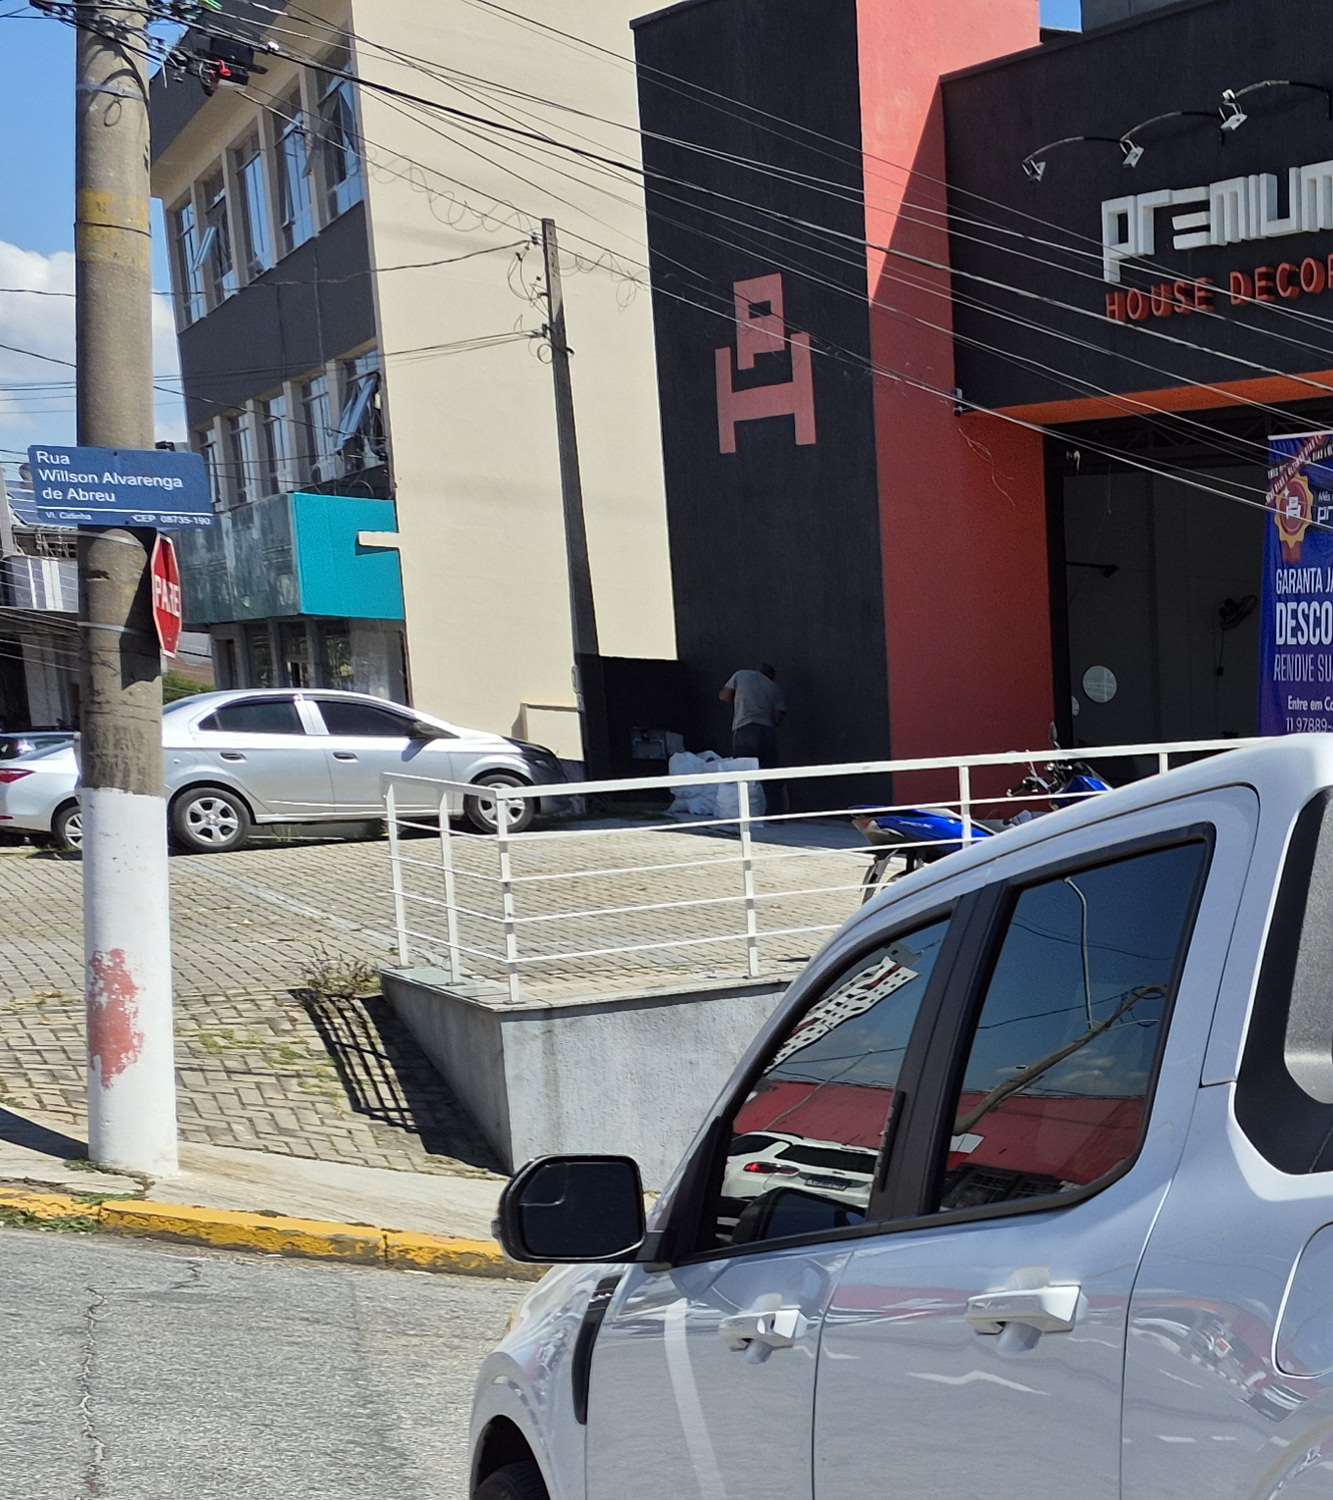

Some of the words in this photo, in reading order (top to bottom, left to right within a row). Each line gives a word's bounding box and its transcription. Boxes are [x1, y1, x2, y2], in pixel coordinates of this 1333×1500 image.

[1105, 277, 1216, 324] HOUSE
[36, 450, 71, 465] Rua
[38, 468, 99, 485] Willson
[102, 471, 184, 491] Alvarenga
[42, 486, 63, 500] de
[66, 488, 116, 503] Abreu
[133, 515, 157, 523] CEP
[160, 515, 211, 526] 08735-190
[1275, 567, 1323, 595] GARANTA
[1273, 653, 1315, 682] RENOVE
[1287, 695, 1308, 711] Entre
[1310, 700, 1323, 711] em
[1286, 716, 1294, 732] 11
